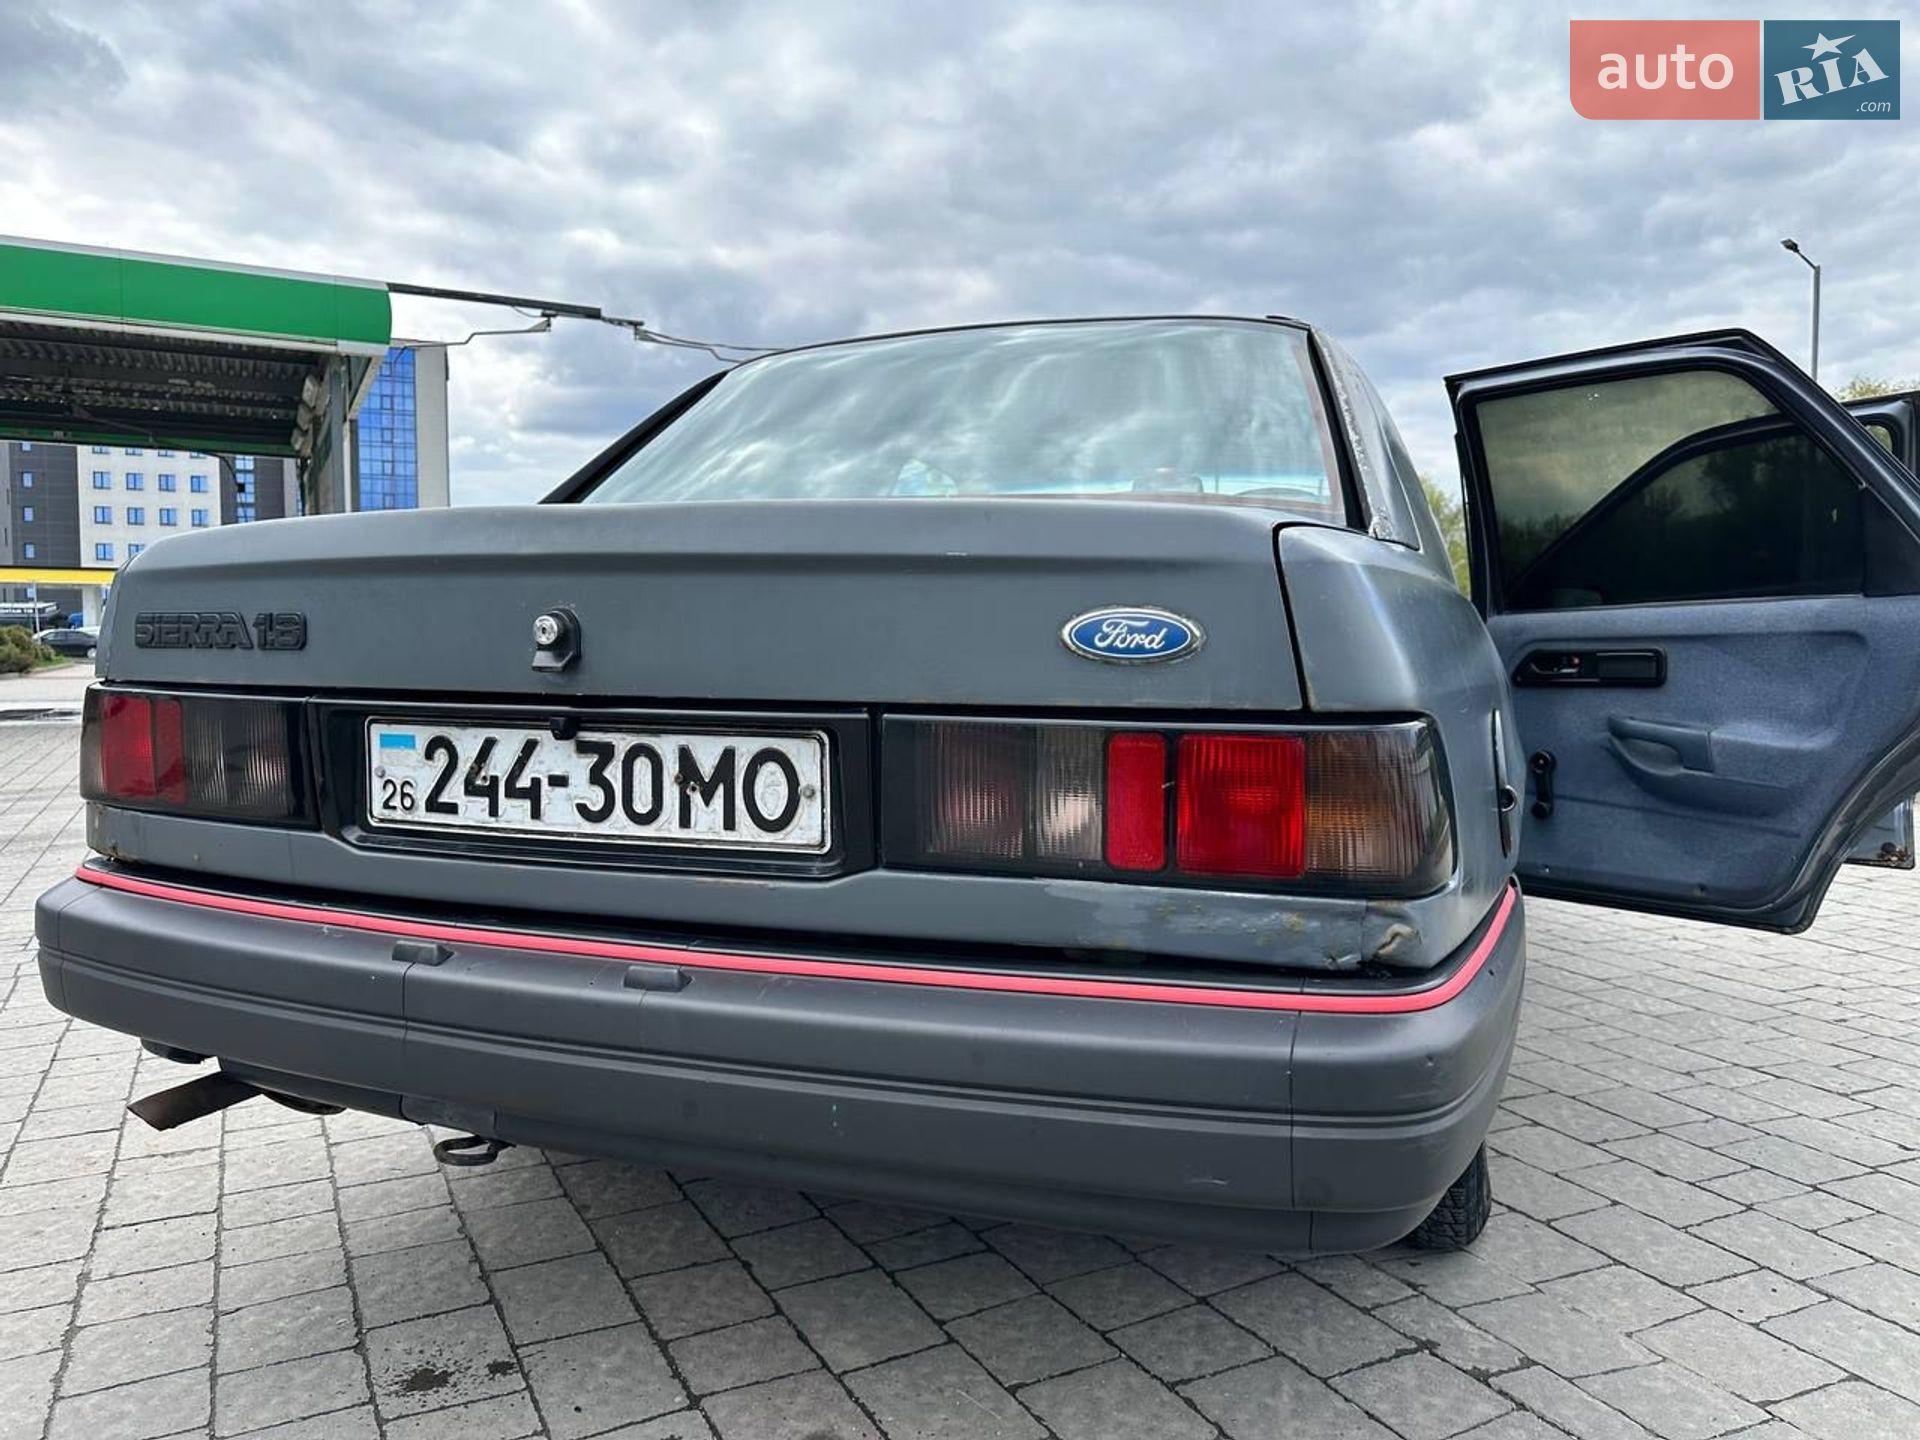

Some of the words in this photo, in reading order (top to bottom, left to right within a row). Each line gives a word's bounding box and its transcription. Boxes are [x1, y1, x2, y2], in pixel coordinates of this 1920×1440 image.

[135, 611, 254, 649] SIERRA
[1094, 618, 1168, 649] Ford
[382, 778, 415, 811] 26
